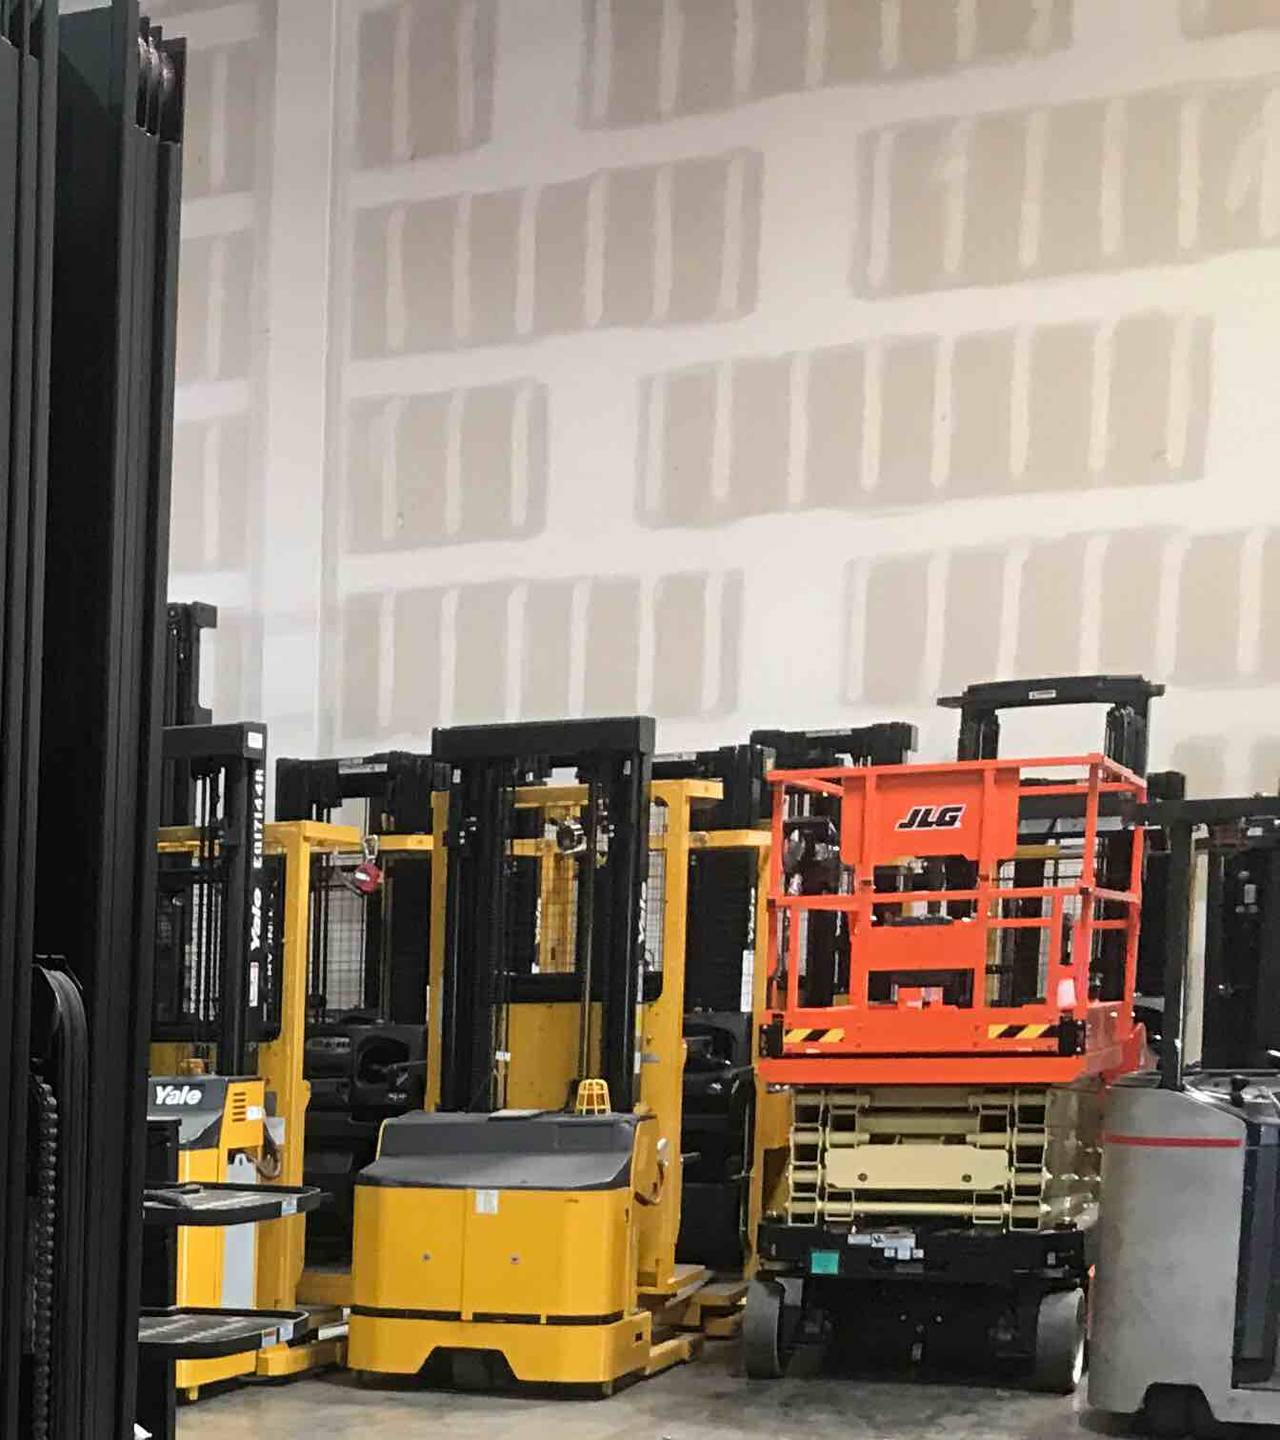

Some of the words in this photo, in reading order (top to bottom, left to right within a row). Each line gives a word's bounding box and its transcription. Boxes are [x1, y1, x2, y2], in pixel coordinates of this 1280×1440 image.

[897, 806, 964, 829] JLG
[250, 887, 262, 951] Yale
[155, 1085, 202, 1105] Yale
